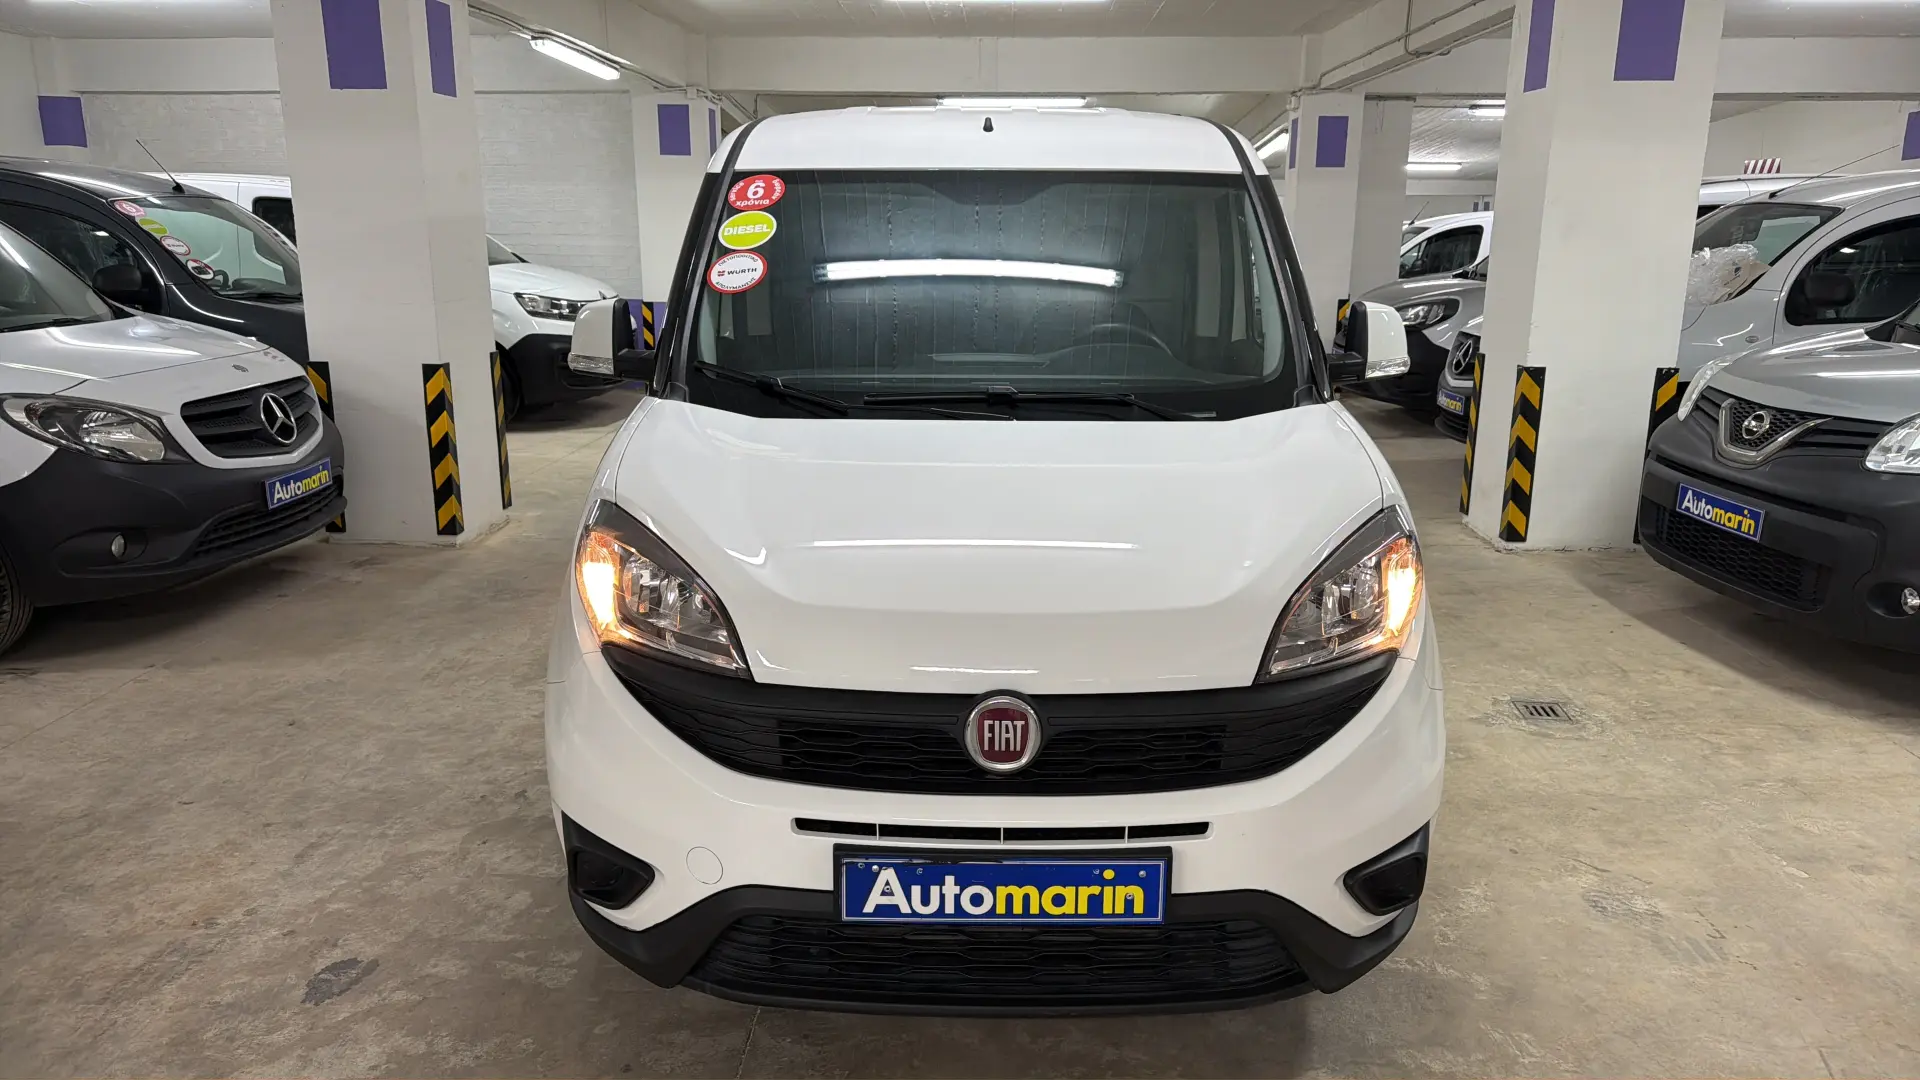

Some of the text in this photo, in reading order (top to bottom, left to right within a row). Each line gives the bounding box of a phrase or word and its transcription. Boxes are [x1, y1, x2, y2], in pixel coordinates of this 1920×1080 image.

[735, 198, 770, 207] χρόνια
[746, 182, 766, 199] 6
[723, 224, 771, 236] DIESEL
[273, 465, 329, 503] Automarin
[1681, 489, 1755, 535] Automarin
[983, 720, 1025, 751] FIAT
[862, 866, 1144, 915] Automarin
